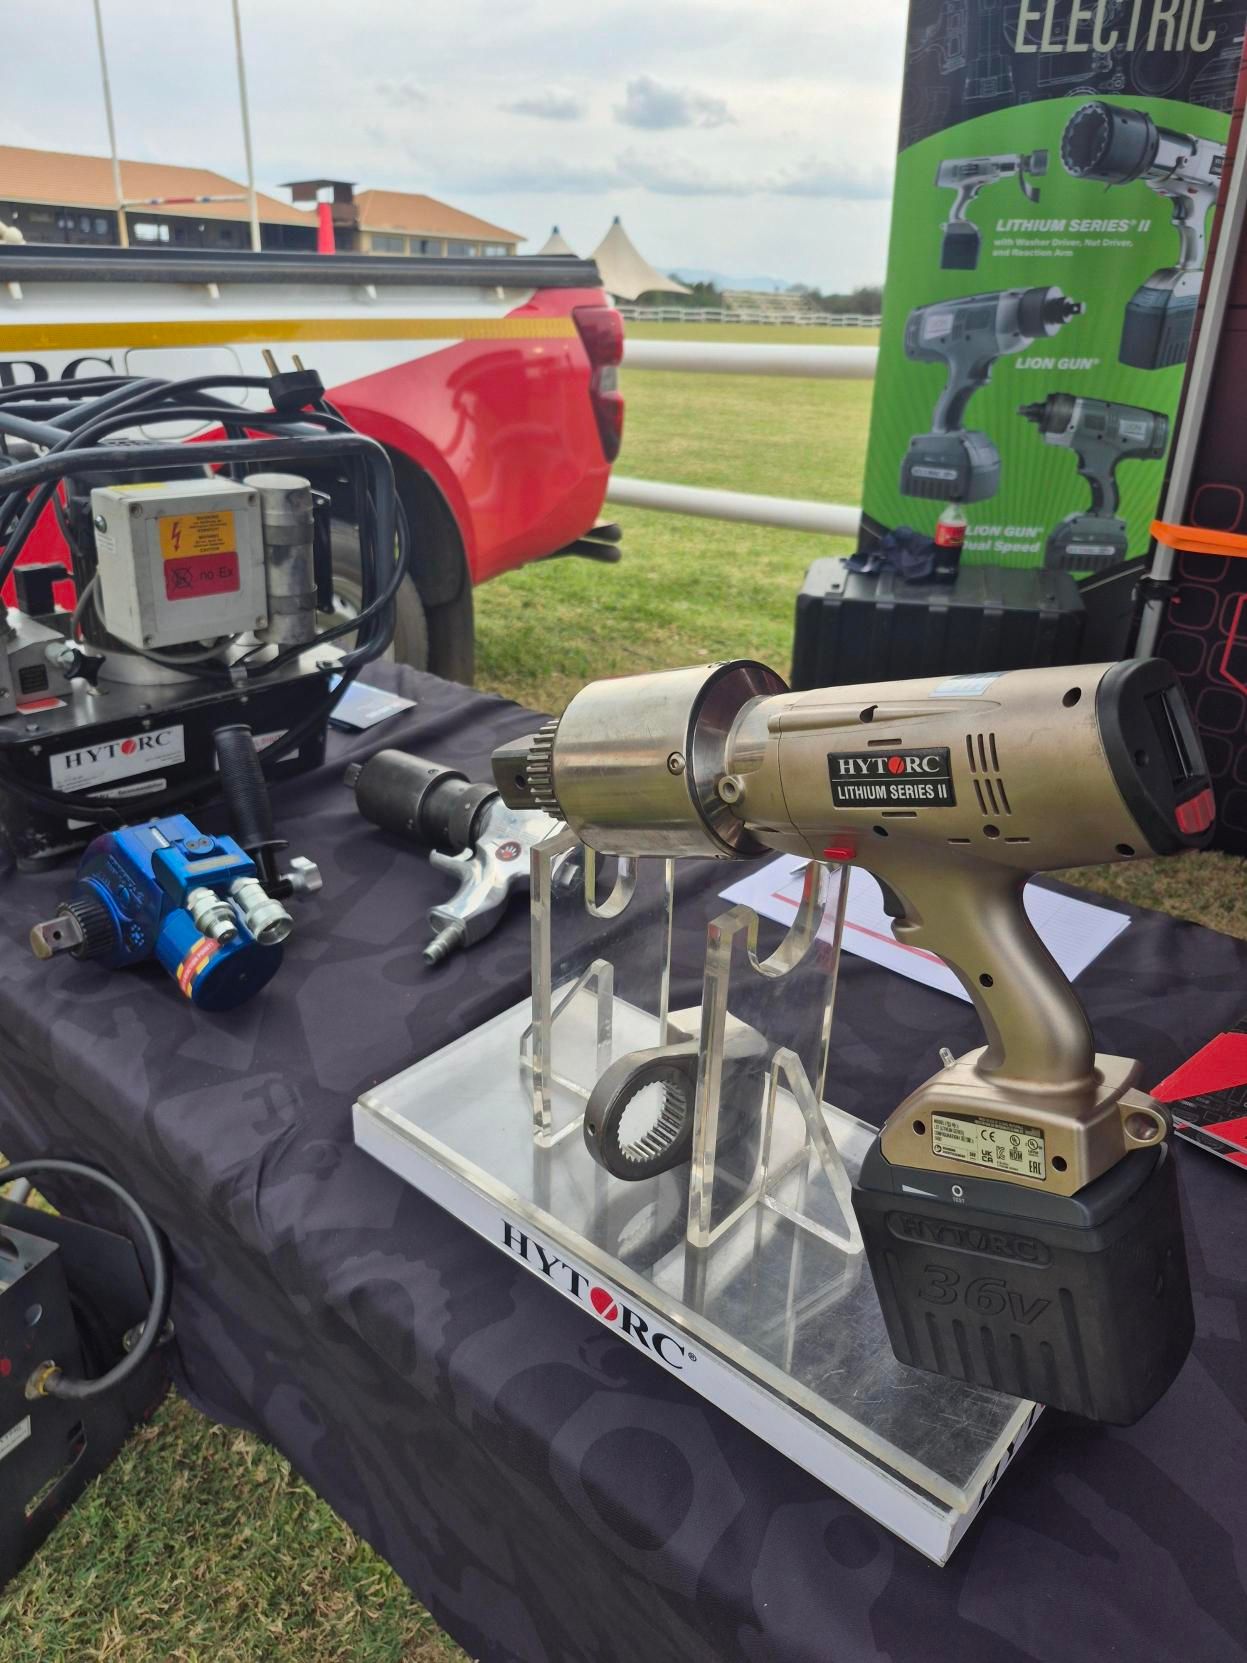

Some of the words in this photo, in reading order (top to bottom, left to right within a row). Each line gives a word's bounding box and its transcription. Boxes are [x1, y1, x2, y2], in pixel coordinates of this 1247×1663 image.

[1014, 0, 1223, 53] ELECTRIC
[995, 219, 1067, 232] LITHIUM
[1138, 219, 1151, 232] II
[993, 238, 1014, 246] with
[1015, 238, 1050, 246] Washer
[1011, 249, 1053, 257] Reaction
[1054, 249, 1073, 257] Arm
[1015, 357, 1055, 369] LION
[965, 525, 1003, 536] LION
[994, 541, 1041, 554] Speed
[65, 730, 172, 769] HYTORC
[838, 755, 941, 775] HYTORC
[837, 785, 887, 800] LITHIUM
[889, 784, 935, 799] SERIES
[938, 784, 947, 798] II
[901, 1215, 1040, 1262] HYTORC
